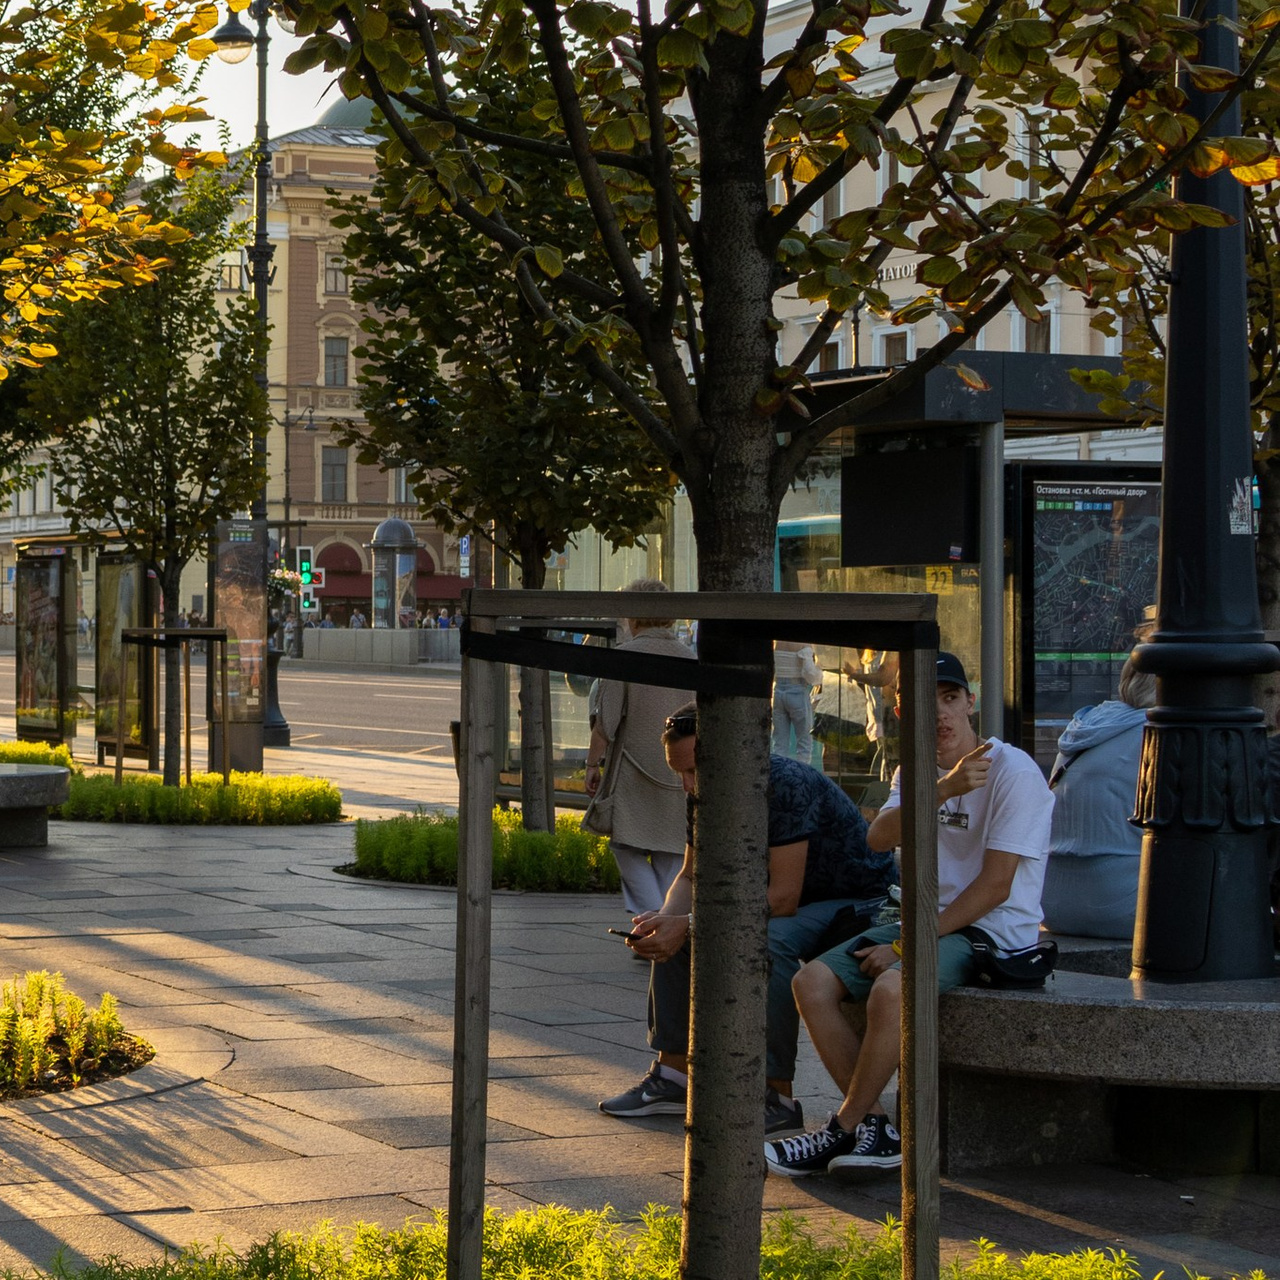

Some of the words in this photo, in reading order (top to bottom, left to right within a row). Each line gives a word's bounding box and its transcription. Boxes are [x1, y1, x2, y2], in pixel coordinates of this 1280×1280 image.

[1036, 485, 1071, 495] Остановка
[1092, 486, 1126, 496] «Гостиный
[1127, 488, 1147, 498] двор»
[462, 537, 468, 554] P
